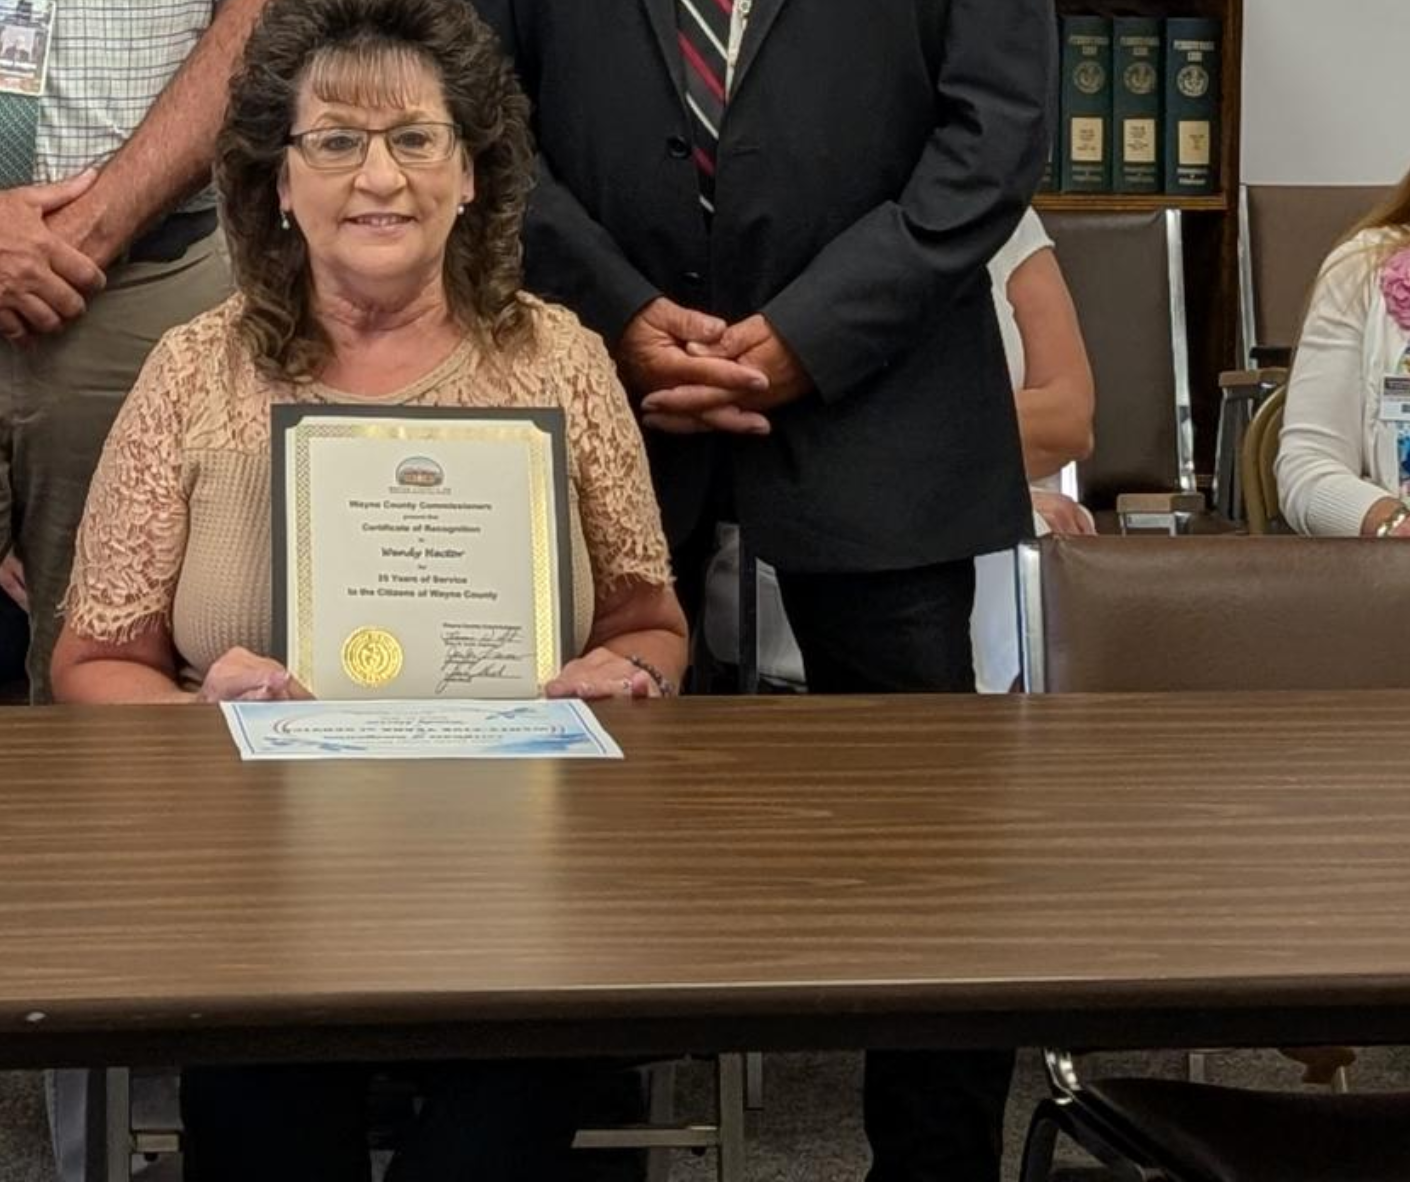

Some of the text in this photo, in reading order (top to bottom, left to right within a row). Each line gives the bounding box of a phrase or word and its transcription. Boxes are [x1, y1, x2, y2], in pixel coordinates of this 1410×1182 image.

[349, 500, 492, 511] Wayne County Commissioners
[362, 522, 481, 535] Certificate of Recognition
[381, 546, 423, 560] Wendy
[391, 574, 418, 583] Years
[420, 574, 431, 584] of
[433, 575, 468, 584] Service
[347, 587, 497, 601] to the Citizens of Wayne County
